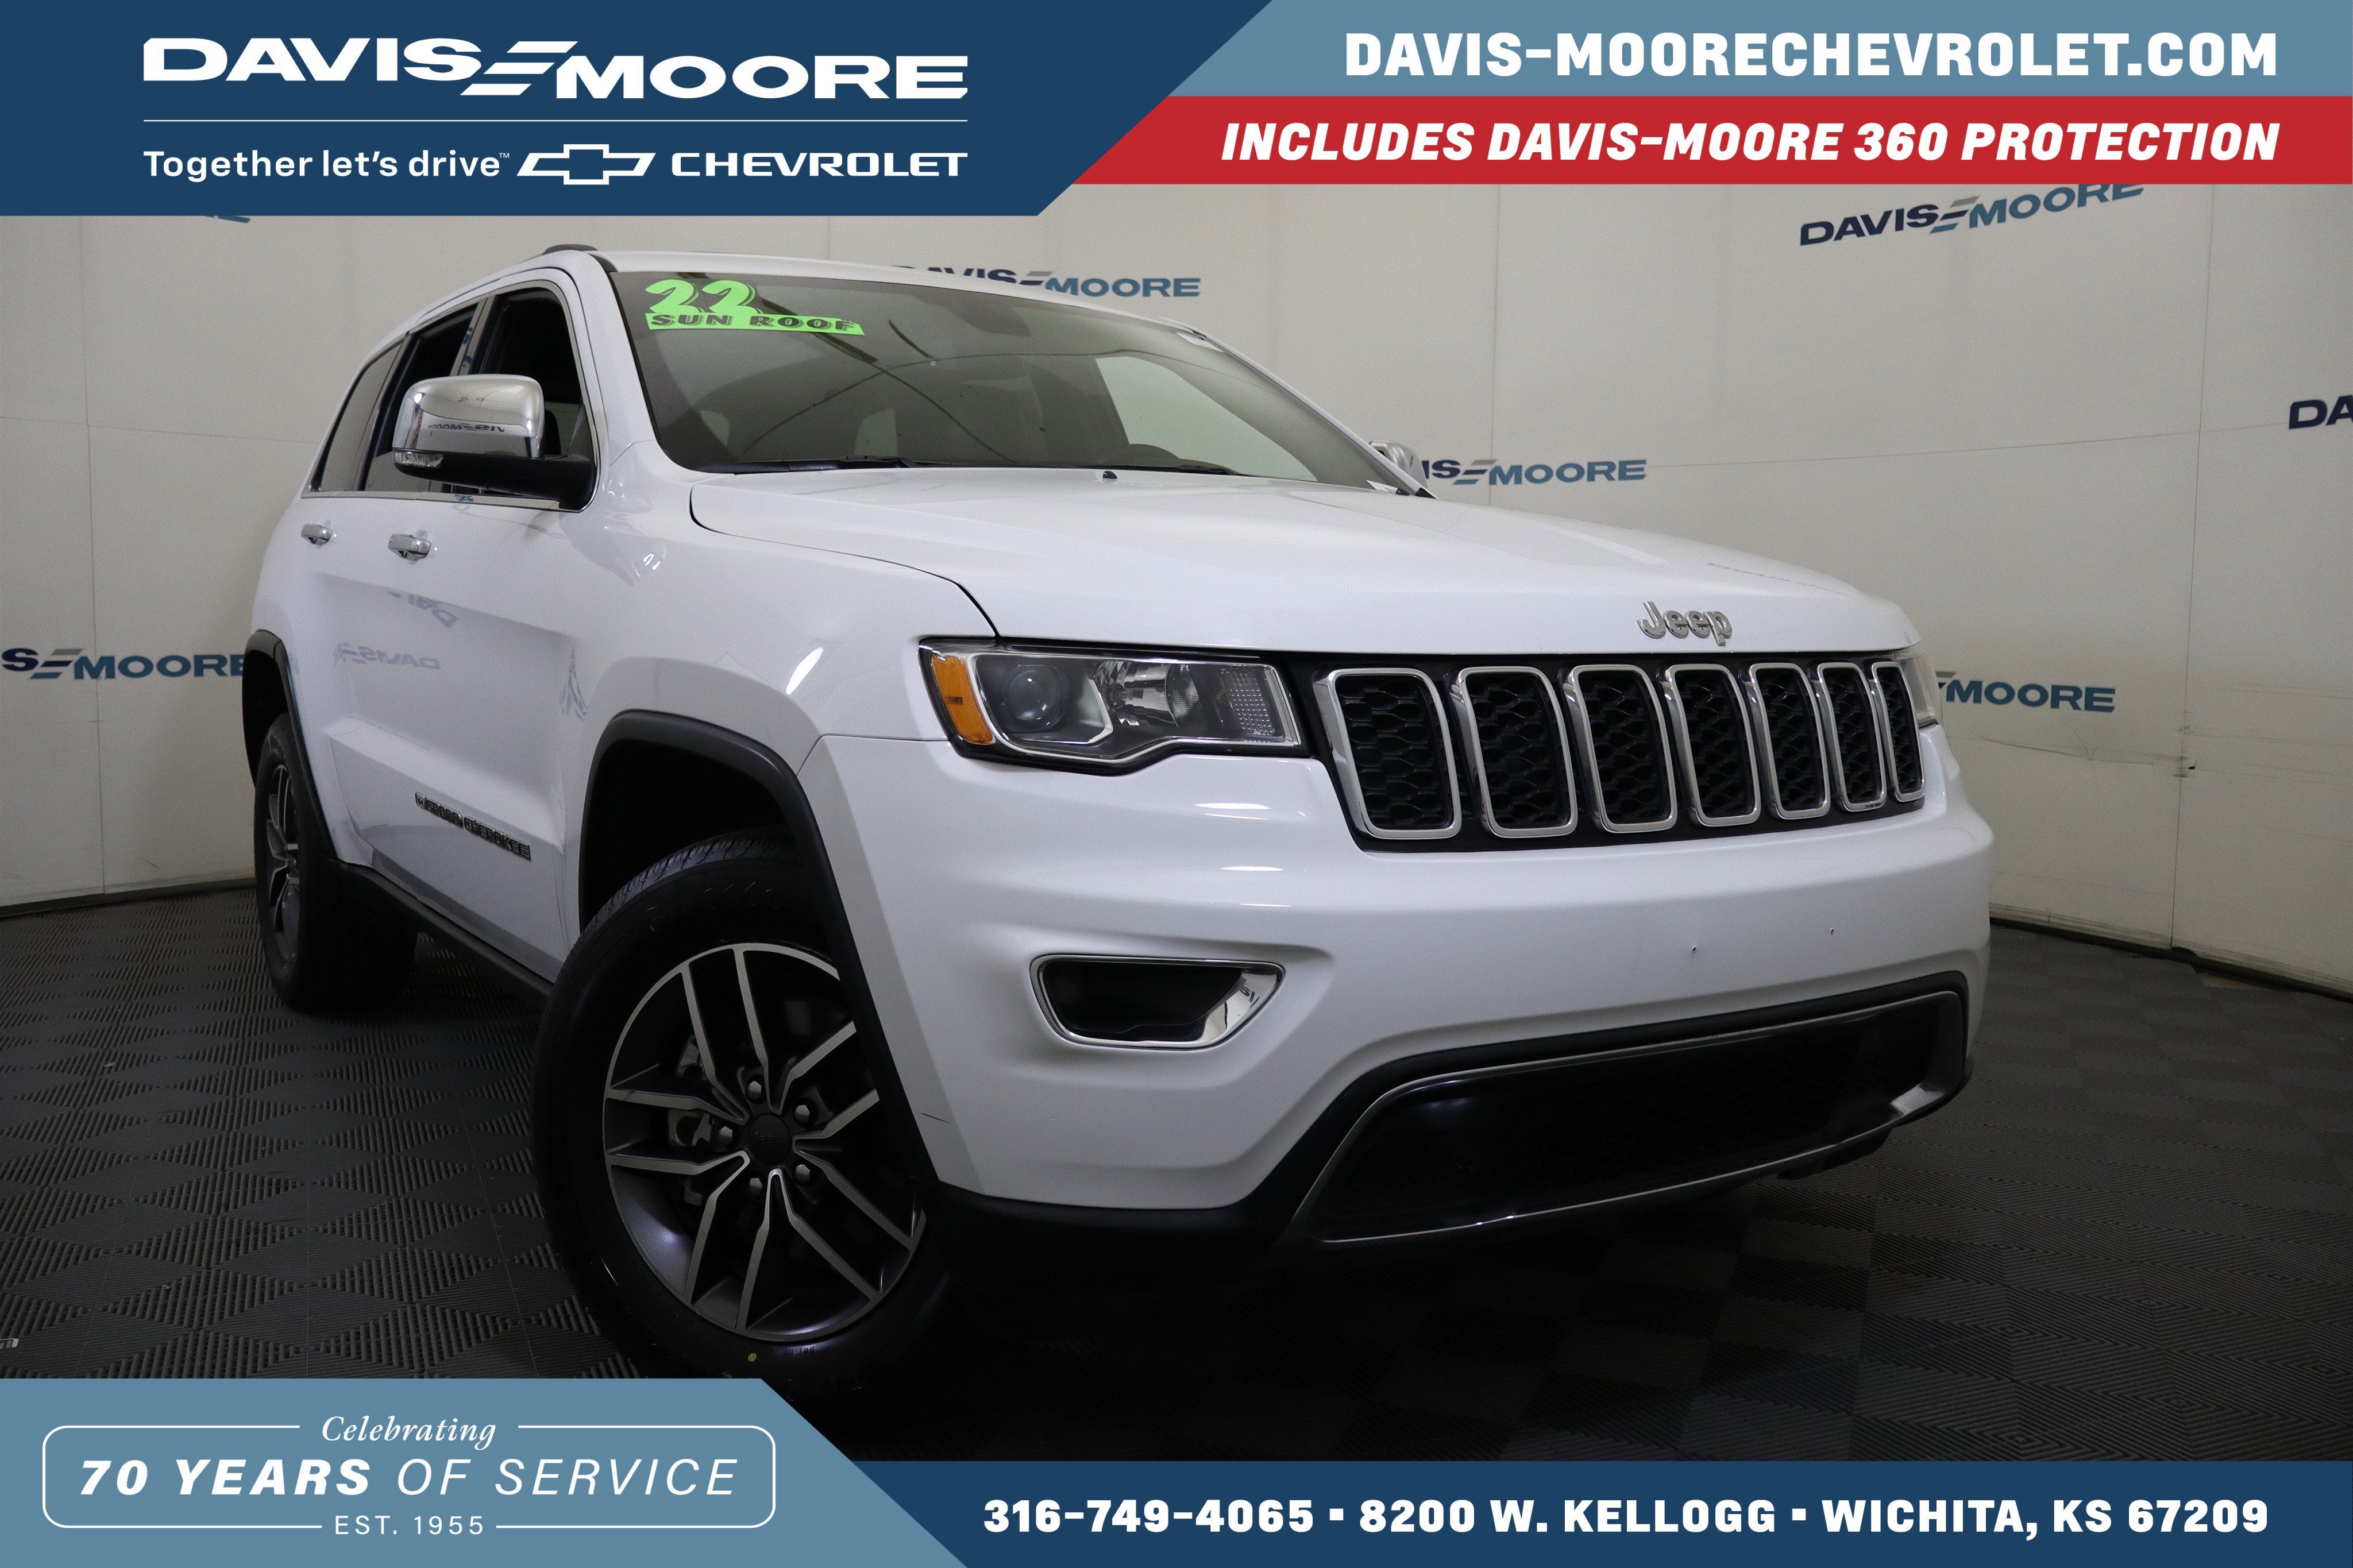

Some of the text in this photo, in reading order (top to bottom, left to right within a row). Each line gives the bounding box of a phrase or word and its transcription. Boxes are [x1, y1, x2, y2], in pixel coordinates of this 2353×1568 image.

[1800, 204, 1939, 246] DAVIS
[645, 279, 764, 314] 22
[1045, 277, 1201, 298] MOORE
[651, 314, 858, 331] SUN ROOF
[1489, 459, 1646, 485] MOORE
[1637, 601, 1732, 647] Jeep
[1946, 679, 2116, 713] MOORE
